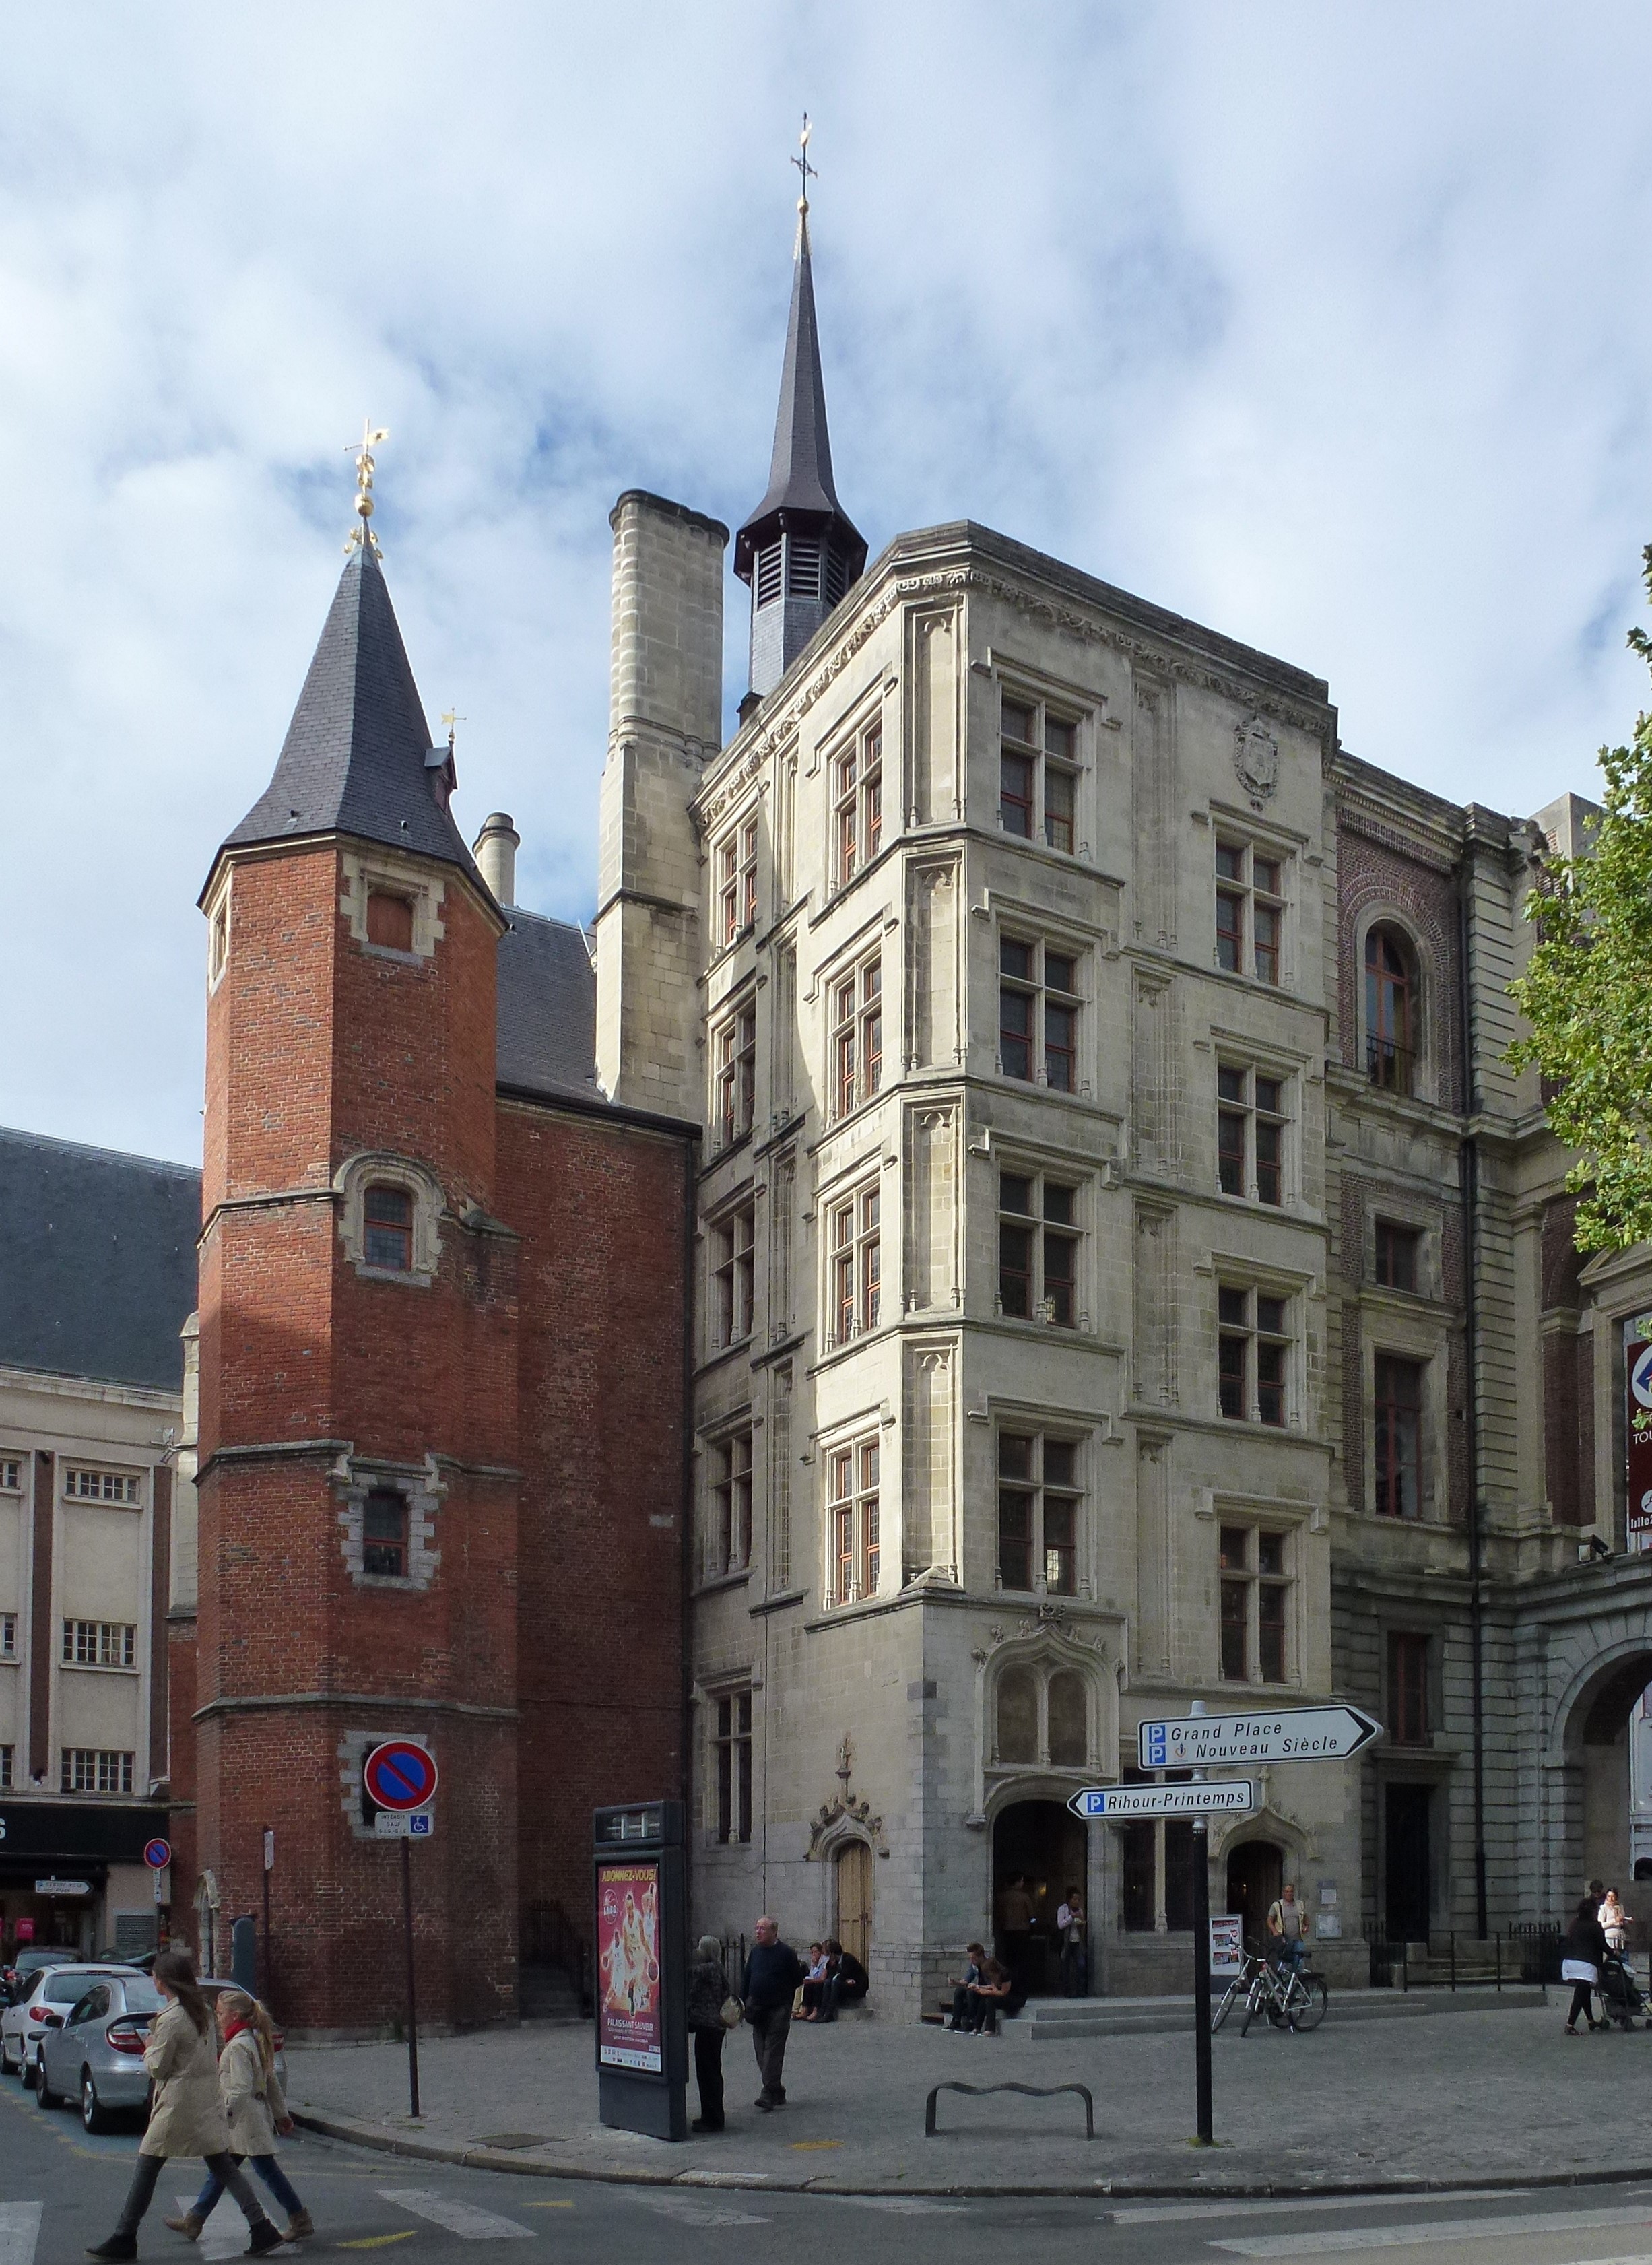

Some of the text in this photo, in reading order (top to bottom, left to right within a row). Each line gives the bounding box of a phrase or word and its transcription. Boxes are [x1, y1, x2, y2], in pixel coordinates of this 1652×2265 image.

[1171, 1724, 1221, 1742] Grand
[1234, 1721, 1282, 1738] Place
[1195, 1742, 1269, 1759] Nouveau
[1282, 1735, 1339, 1752] Siècle
[1107, 1792, 1245, 1810] Rihour-Printemps
[607, 2018, 622, 2027] PALAIS
